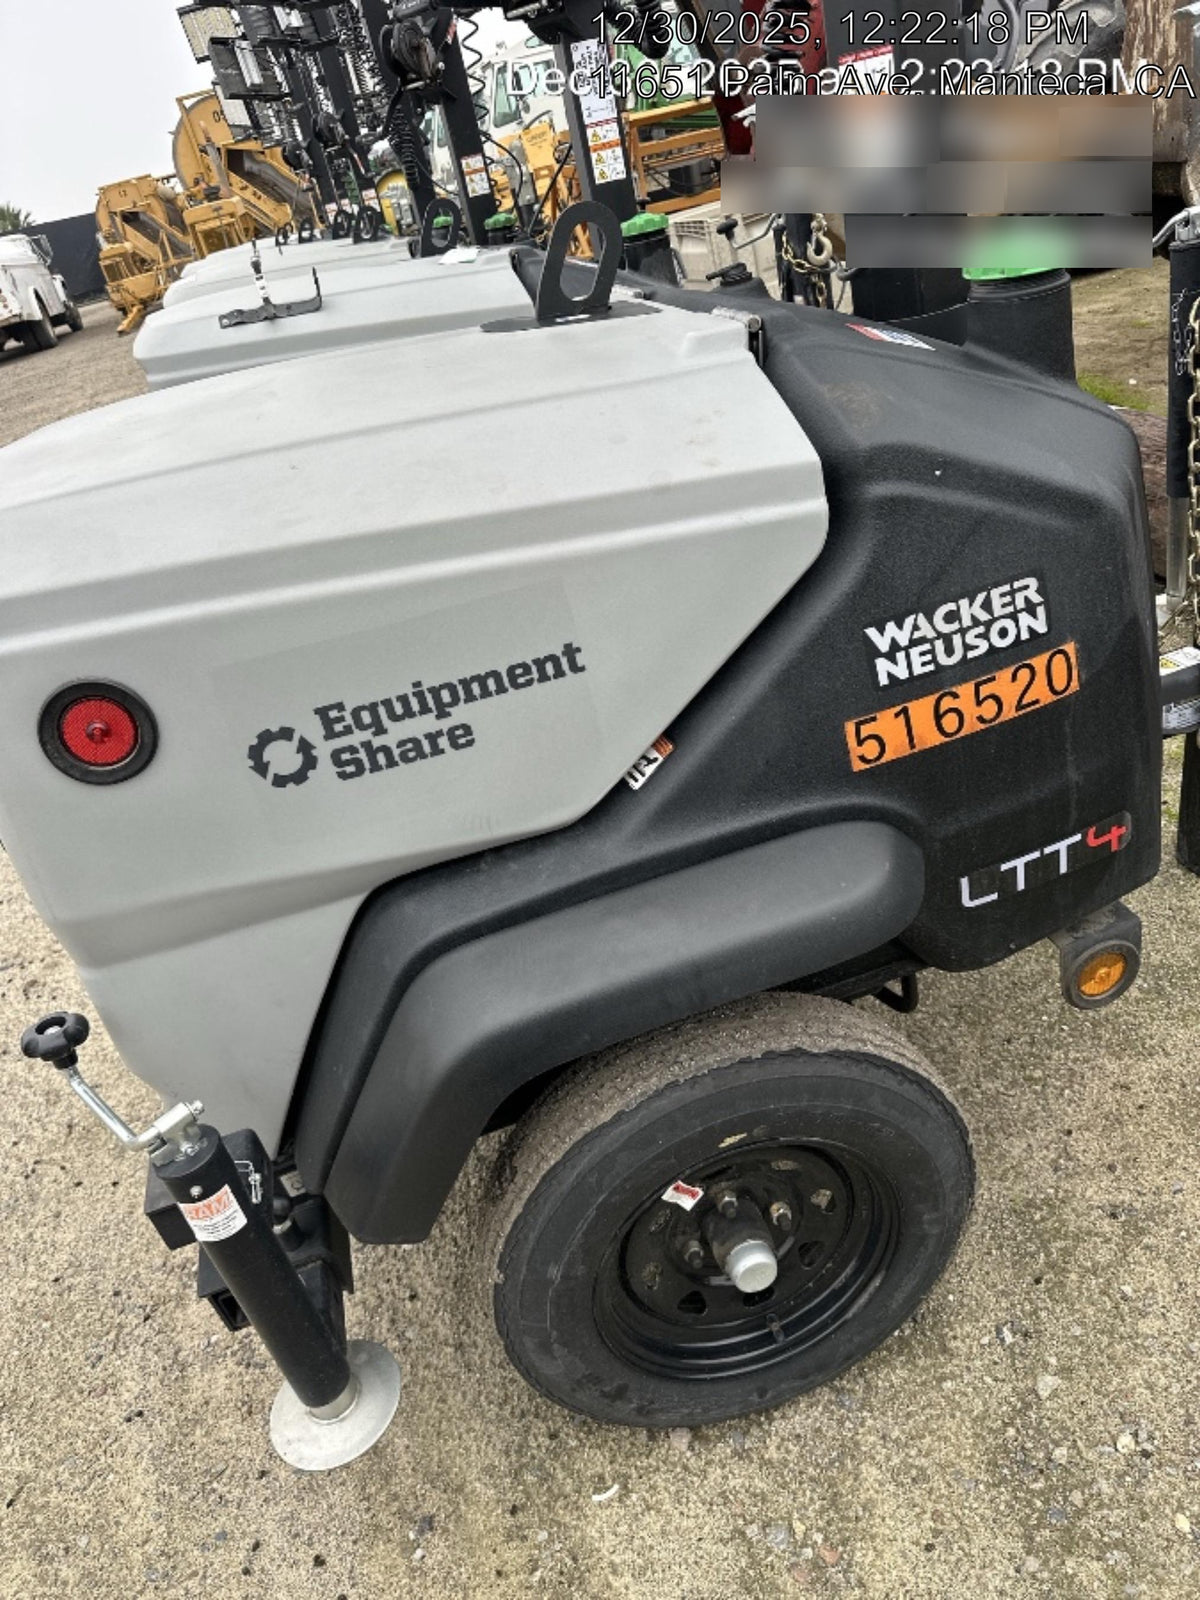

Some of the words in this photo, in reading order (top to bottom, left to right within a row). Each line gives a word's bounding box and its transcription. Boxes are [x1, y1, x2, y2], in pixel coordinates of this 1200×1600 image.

[864, 577, 1044, 653] WACKER
[875, 604, 1048, 687] NEUSON
[313, 642, 586, 741] Equipment
[854, 648, 1073, 766] 516520
[330, 722, 476, 781] Share
